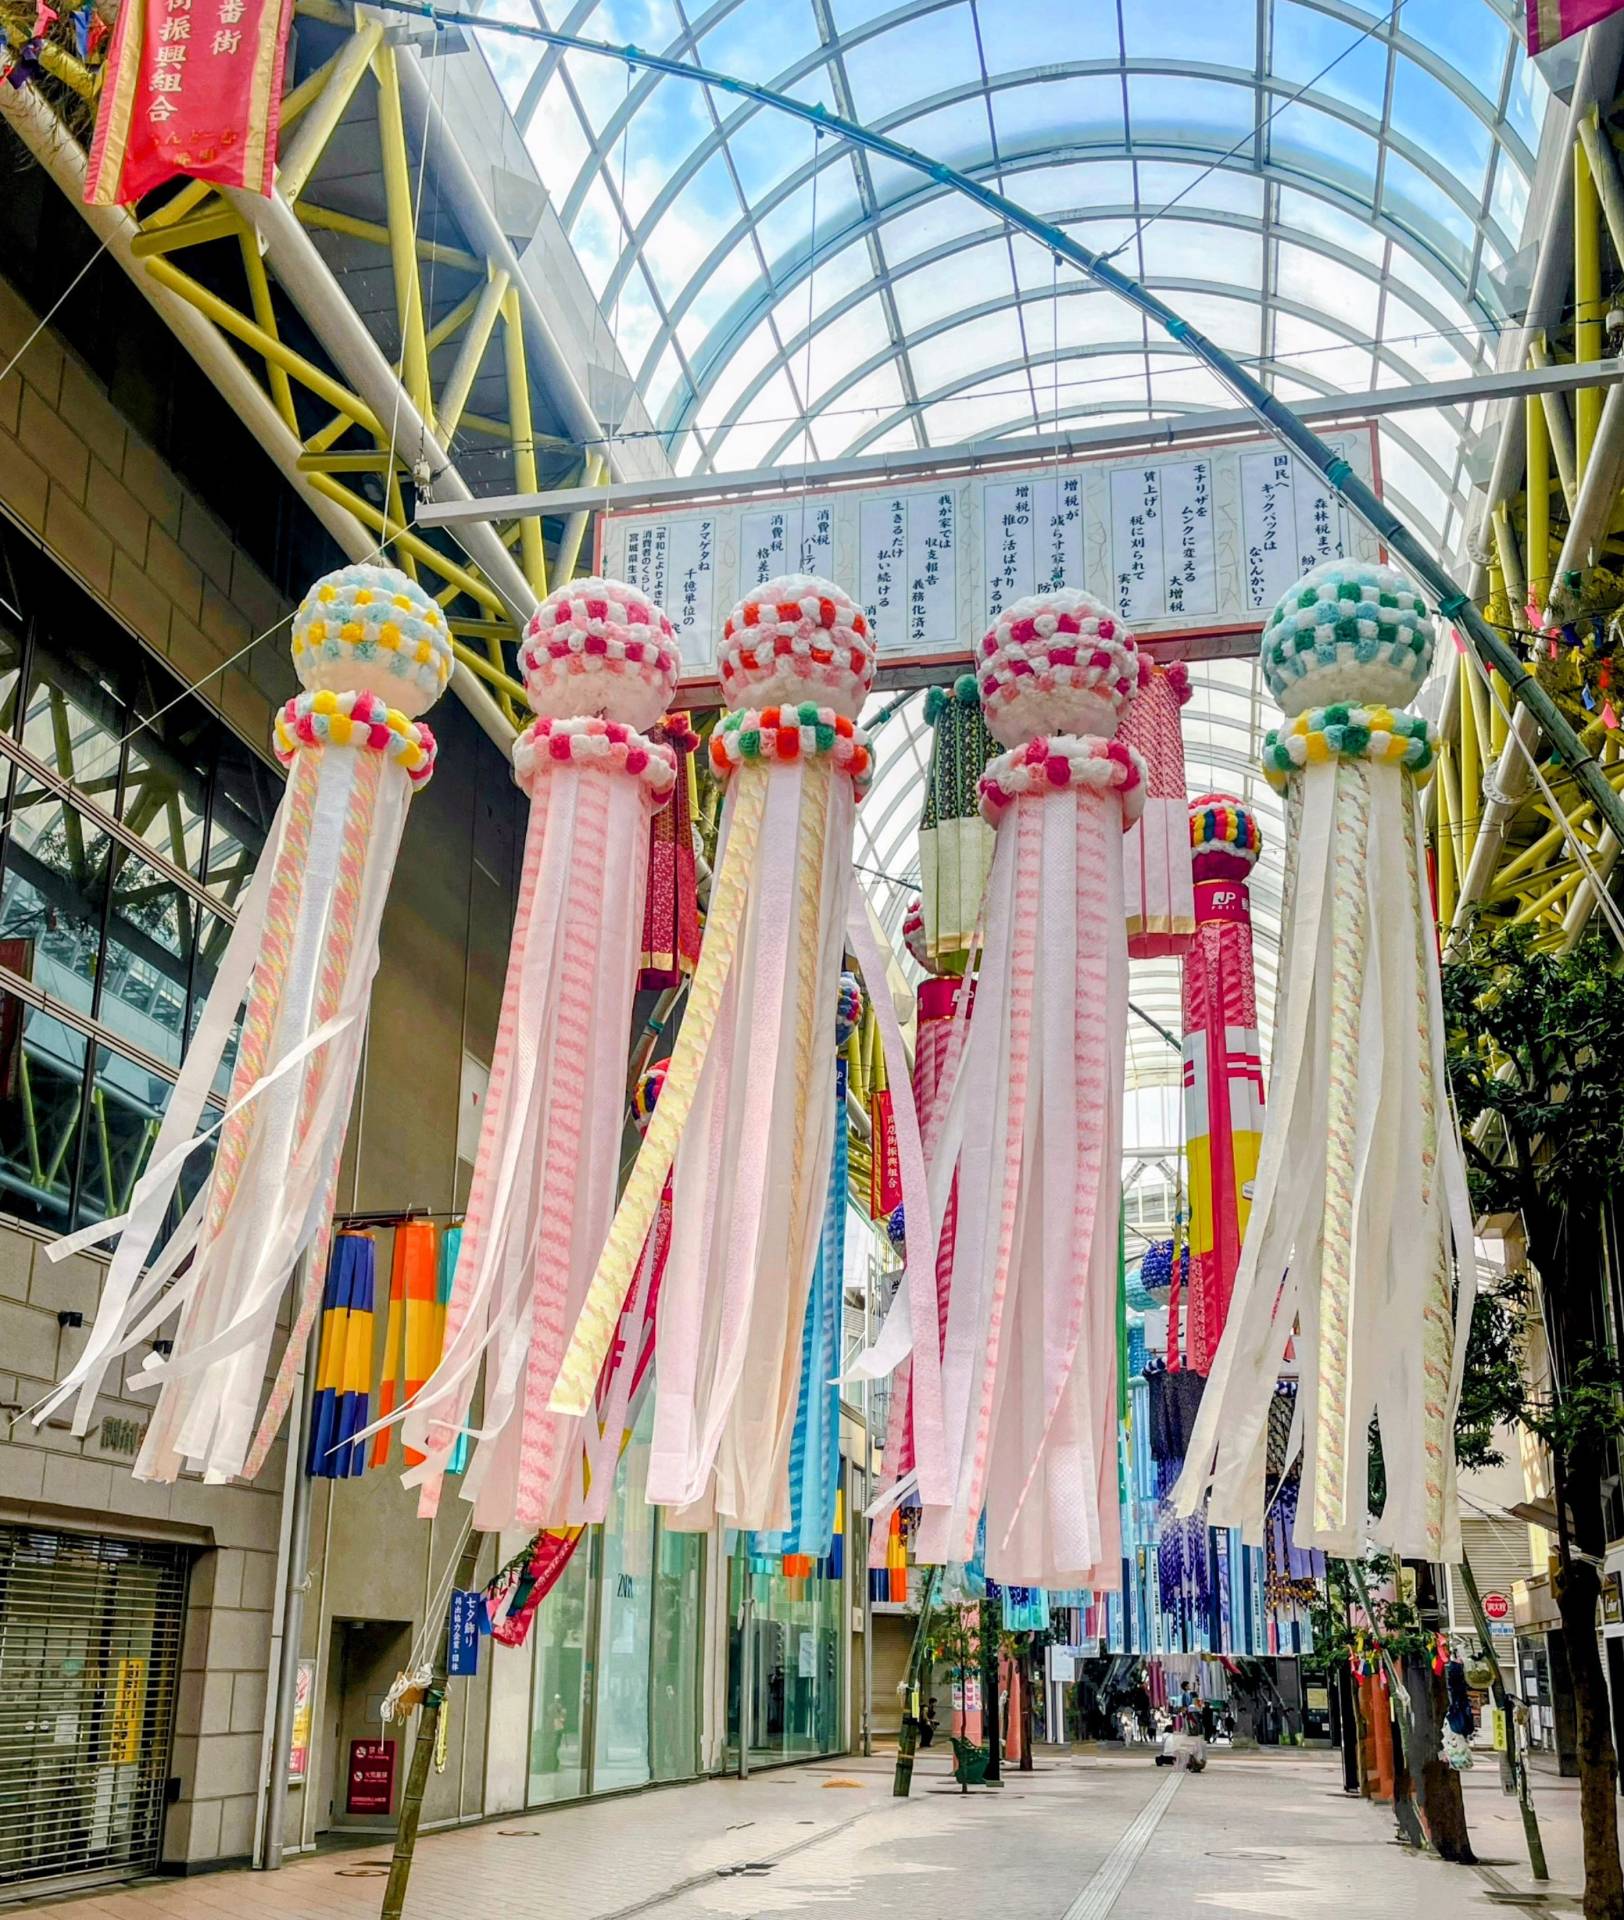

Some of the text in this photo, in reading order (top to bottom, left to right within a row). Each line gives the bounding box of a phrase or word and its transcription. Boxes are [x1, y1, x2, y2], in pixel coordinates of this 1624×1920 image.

[1144, 471, 1159, 518] 賃上げも
[1193, 464, 1209, 517] モナリザを
[1274, 455, 1290, 488] 国民へ
[938, 494, 952, 549] 我が家では
[1016, 485, 1031, 525] 増税の
[1064, 480, 1080, 521] 増税が
[1261, 483, 1278, 551] キックバックは
[698, 522, 711, 571] タマゲタね
[770, 514, 784, 551] 消費税
[817, 509, 830, 545] 消費税
[891, 500, 905, 558] 生きるだけ
[1002, 514, 1017, 588] 推し活ばかり
[1130, 515, 1145, 581] 税に刈られて
[1182, 506, 1197, 582] ムンクに変える
[1314, 498, 1331, 556] 森林税まで
[877, 550, 892, 608] 払い続ける
[925, 537, 939, 586] 収支報告
[683, 568, 697, 626] 千億単位の
[912, 578, 926, 640] 義務化済み
[1118, 573, 1132, 618] 実りなし
[1169, 575, 1185, 612] 大増税
[865, 605, 878, 644] 消費
[464, 1596, 477, 1648] 七夕飾り
